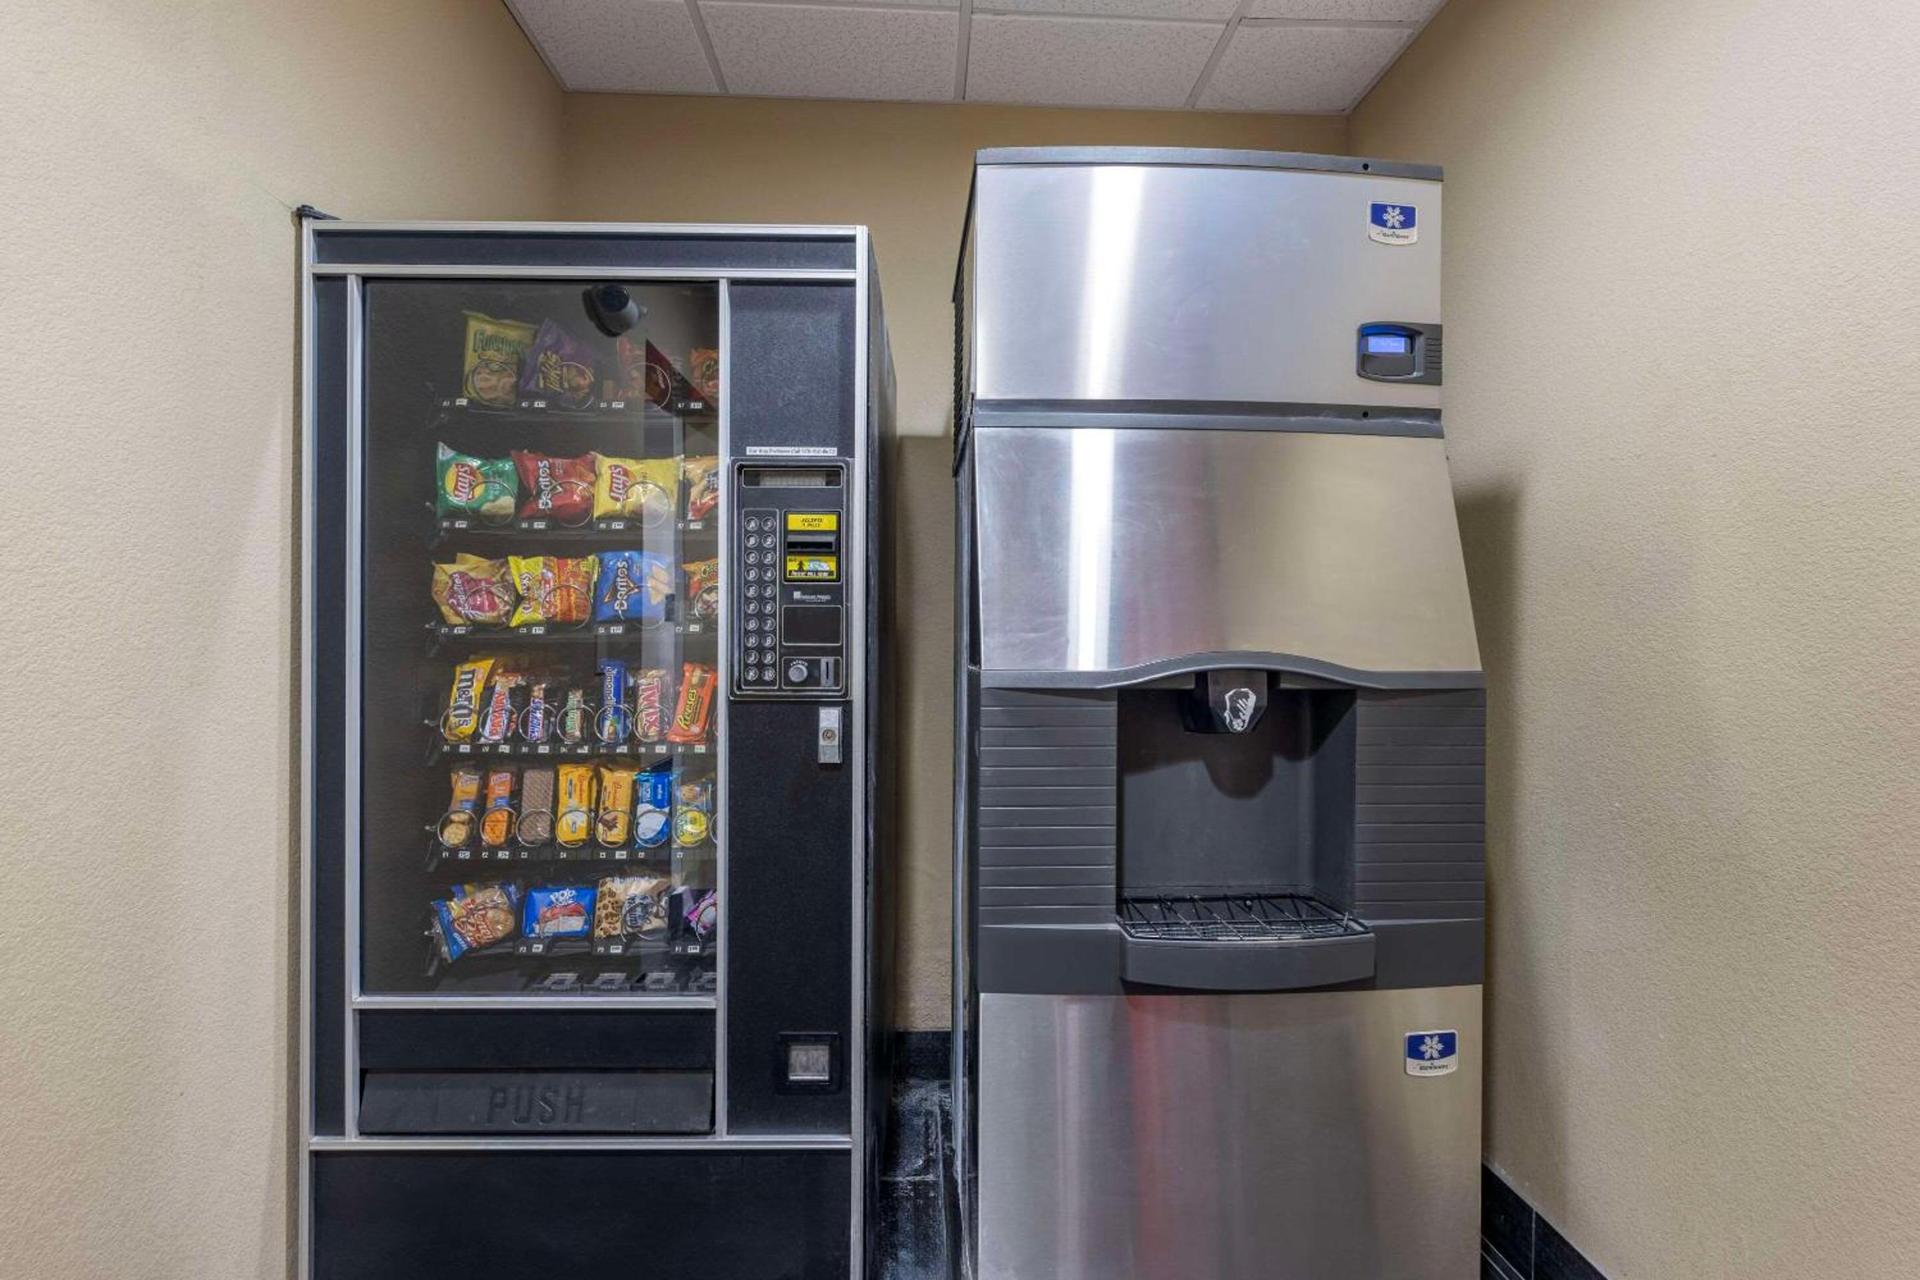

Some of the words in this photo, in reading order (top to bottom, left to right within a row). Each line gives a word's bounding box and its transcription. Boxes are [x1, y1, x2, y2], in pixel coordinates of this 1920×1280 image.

[538, 460, 553, 510] Doritos
[614, 560, 628, 611] Doritos
[487, 1085, 584, 1124] PUSH
